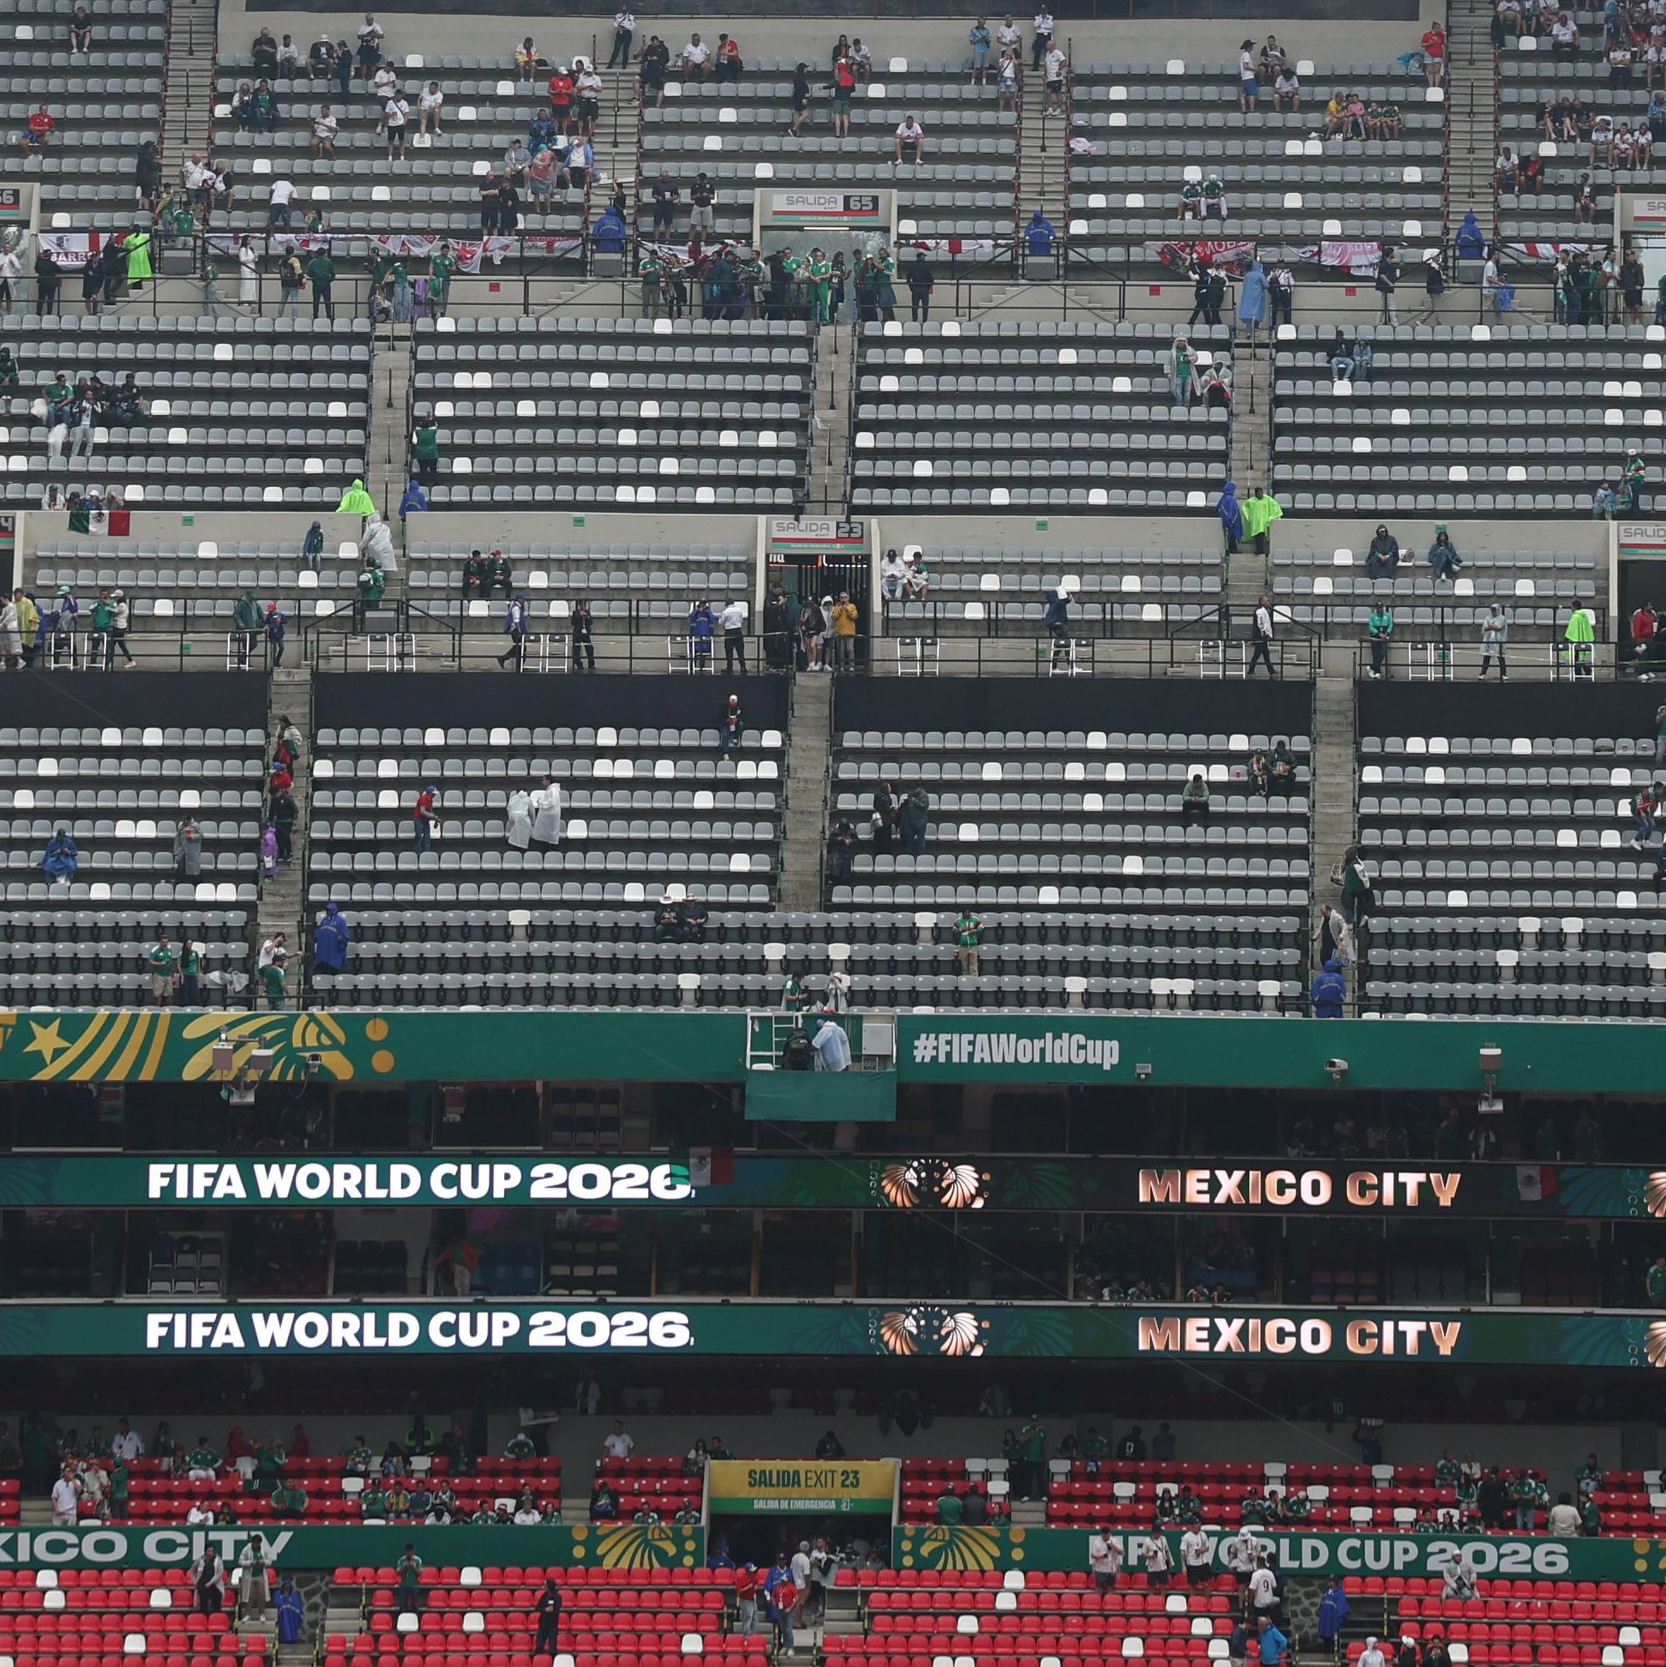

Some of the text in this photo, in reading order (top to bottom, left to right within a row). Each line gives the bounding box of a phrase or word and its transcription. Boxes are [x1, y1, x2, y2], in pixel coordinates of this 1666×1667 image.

[786, 196, 873, 210] SALIDA 65
[776, 522, 862, 538] SALIDA 23
[914, 1033, 1119, 1070] #FIFAWorldCup
[149, 1163, 690, 1200] FIFA WORLD CUP 2026
[1139, 1170, 1460, 1206] MEXICO CITY
[147, 1312, 692, 1347] FIFA WORLD CUP 2026
[1139, 1318, 1461, 1355] MEXICO CITY
[748, 1470, 859, 1488] SALIDA EXIT 23
[753, 1500, 836, 1510] SALIDA DE EMERGENCIA
[142, 1530, 293, 1564] CITY
[1336, 1539, 1417, 1570] CUP
[1426, 1540, 1569, 1573] 2026
